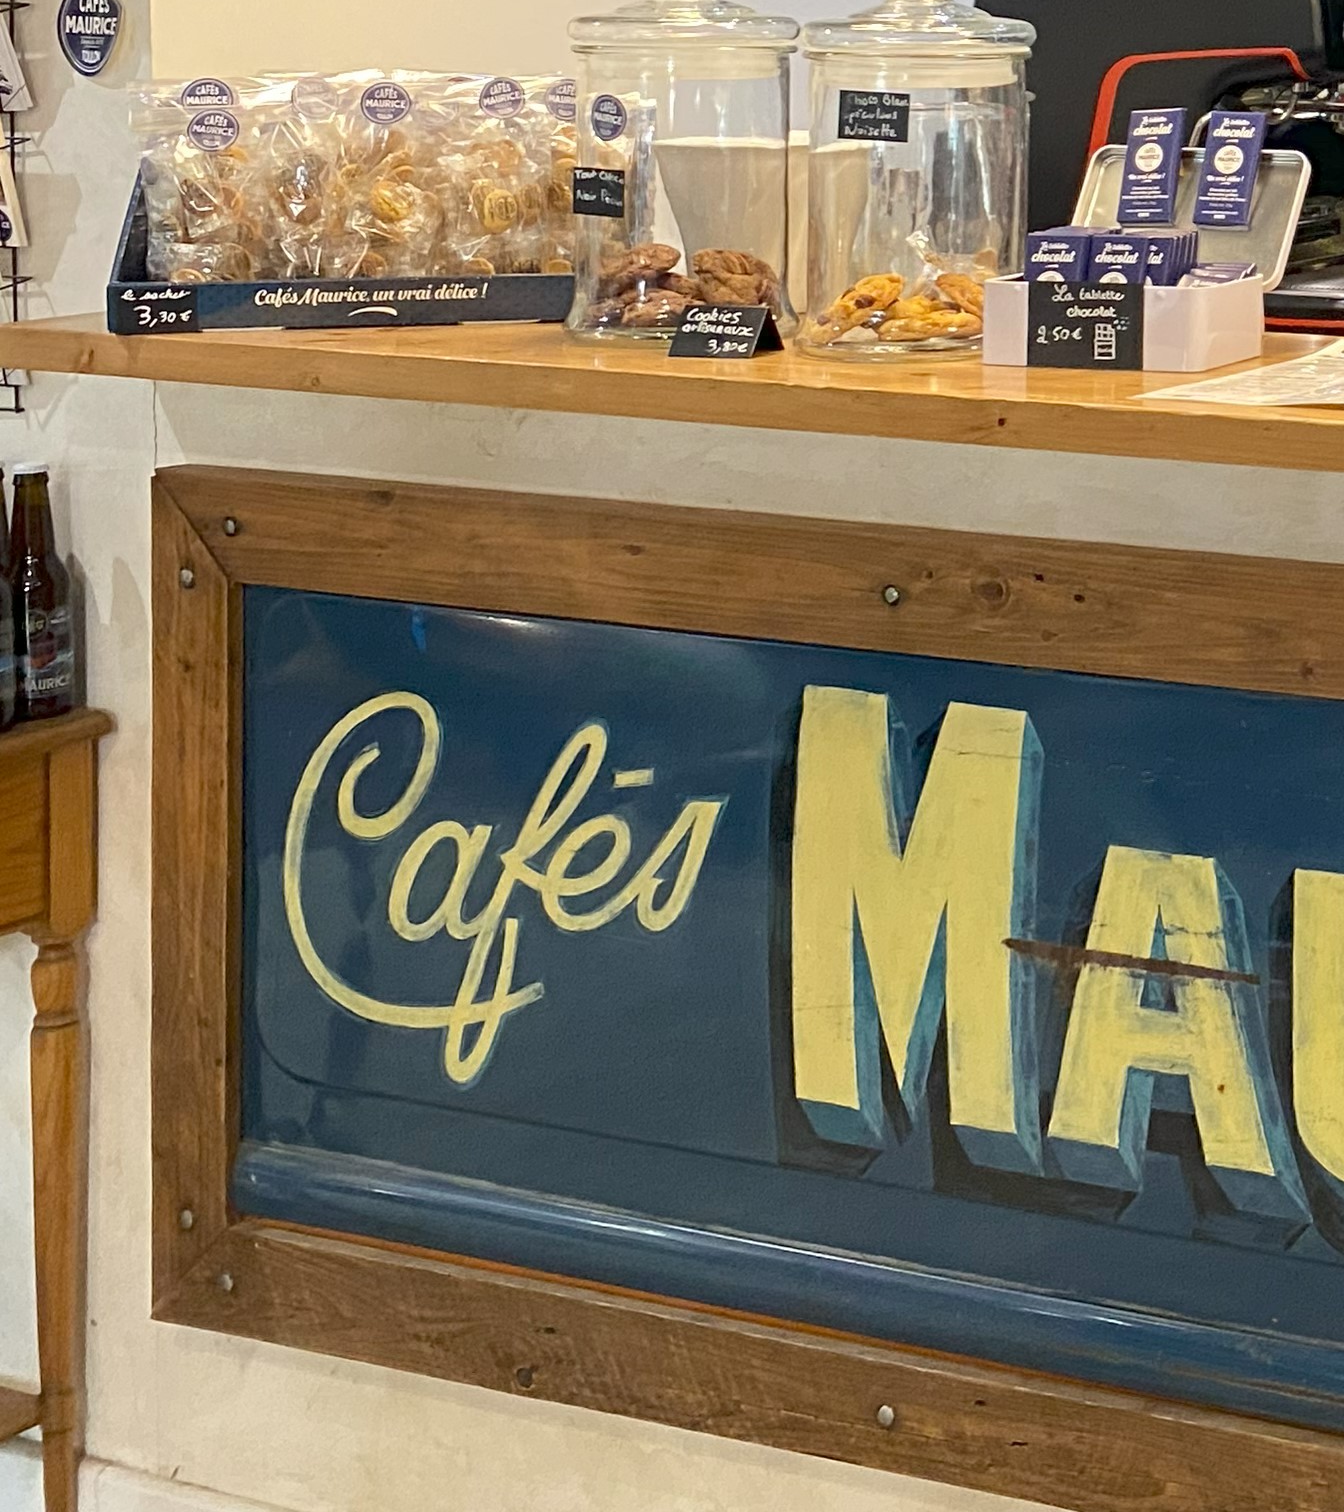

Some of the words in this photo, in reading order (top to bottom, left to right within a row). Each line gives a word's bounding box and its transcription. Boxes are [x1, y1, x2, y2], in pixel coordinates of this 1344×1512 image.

[65, 14, 118, 36] MAURICE
[195, 83, 220, 96] CAFÉS
[374, 88, 398, 100] CAFÉS
[186, 95, 229, 105] MAURICE
[365, 98, 406, 110] MAURICE
[191, 123, 235, 138] MAURICE
[1132, 123, 1174, 137] chocolat
[1212, 125, 1256, 139] chocolat
[1031, 250, 1076, 263] chocolat
[1094, 251, 1140, 265] chocolat
[253, 286, 299, 308] Cafés
[372, 289, 396, 302] un
[397, 284, 432, 301] vrai
[433, 282, 478, 300] délice
[480, 282, 489, 300] !
[1051, 283, 1076, 303] La
[1079, 287, 1126, 302] tablette
[686, 307, 743, 325] Cookies
[1065, 304, 1118, 319] chocolat
[281, 689, 730, 1088] Cafés
